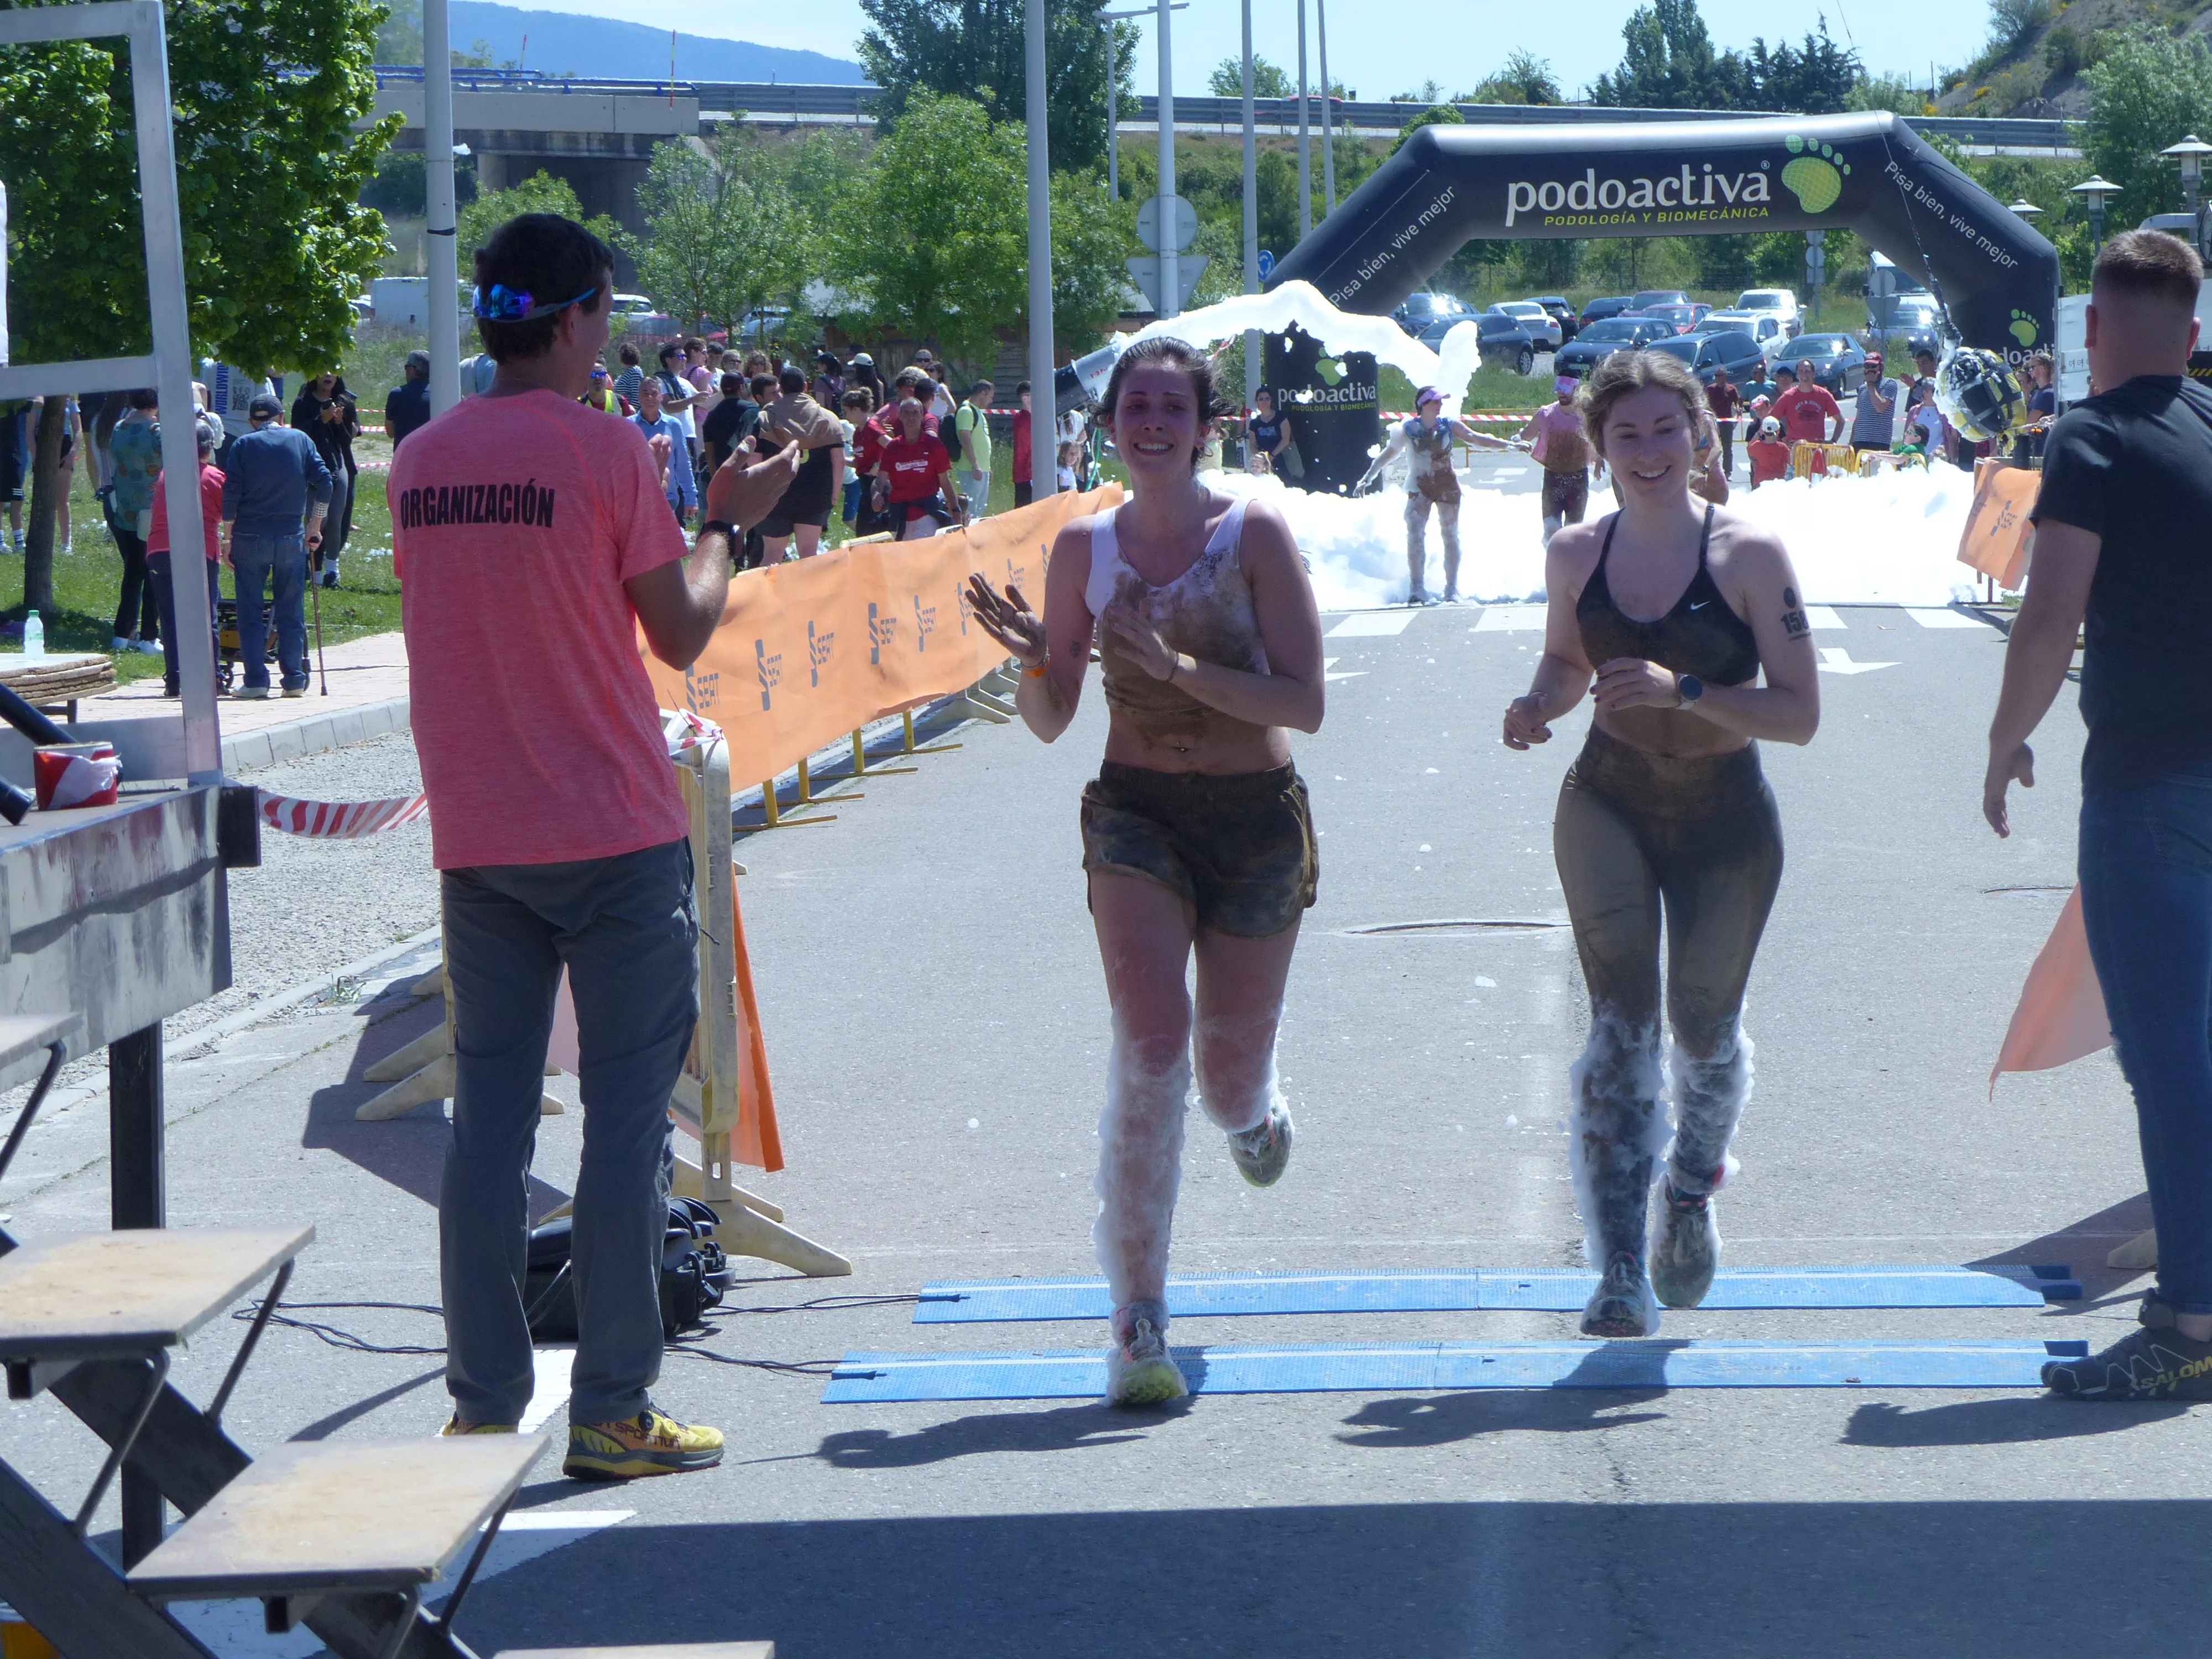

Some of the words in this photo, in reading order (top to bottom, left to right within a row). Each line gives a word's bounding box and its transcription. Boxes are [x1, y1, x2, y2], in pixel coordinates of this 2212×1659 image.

[1505, 163, 1770, 227] podoactiva
[1545, 210, 1636, 226] PODOLOGÍA
[1644, 213, 1651, 223] Y
[1657, 206, 1769, 222] BIOMECÁNICA
[1885, 161, 1913, 191] Pisa
[1914, 186, 1945, 219] bien,
[1949, 215, 1976, 238] vive
[1976, 236, 2018, 268] mejor
[1329, 279, 1362, 307] Pisa
[1357, 252, 1395, 280] bien,
[1391, 225, 1420, 249] vive
[1418, 186, 1455, 226] mejor
[215, 362, 229, 415] WORLDWID
[1292, 404, 1332, 412] PODOLOGÍA
[400, 478, 555, 529] ORGANIZACIÓN
[817, 632, 834, 665] SEAT
[880, 617, 897, 645] SEAT
[767, 654, 784, 687] SEAT
[697, 672, 719, 709] SEAT
[2140, 1356, 2212, 1389] SALOM
